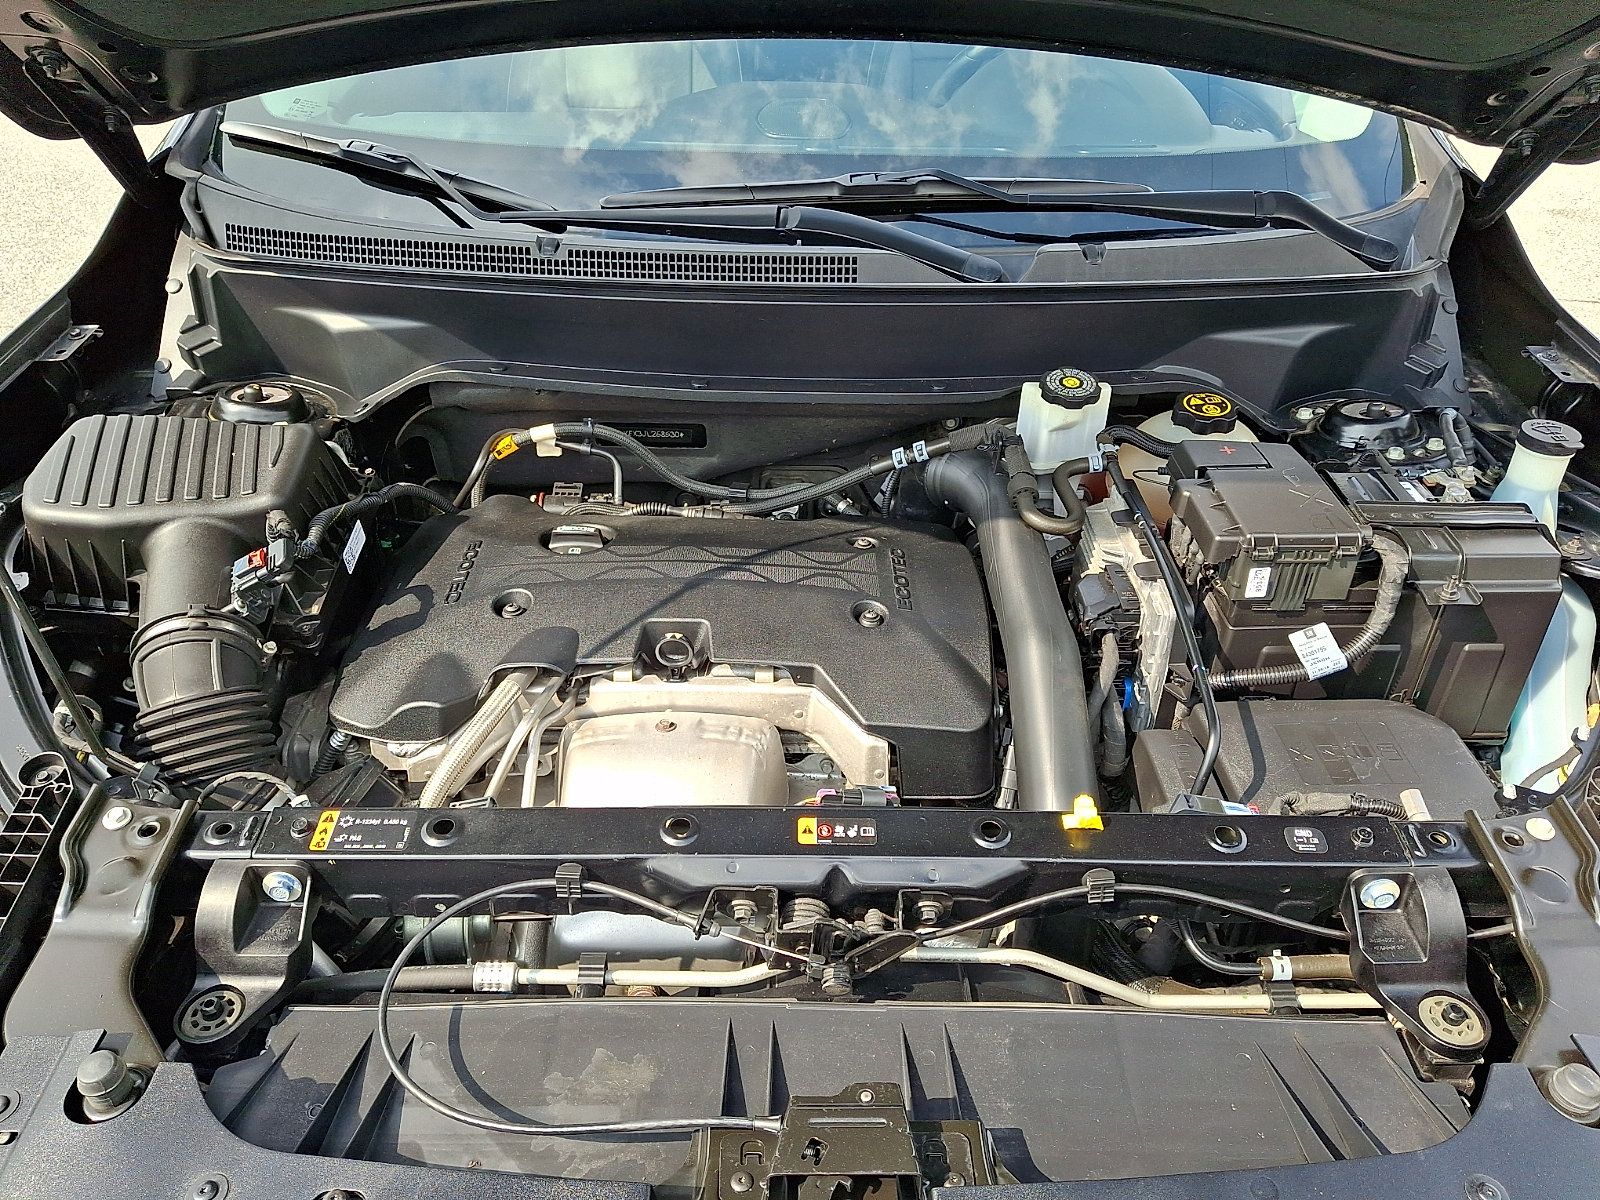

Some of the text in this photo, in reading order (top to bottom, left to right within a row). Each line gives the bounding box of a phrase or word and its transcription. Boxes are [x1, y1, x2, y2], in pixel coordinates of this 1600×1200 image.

[443, 540, 483, 605] ECOTEC
[888, 548, 913, 611] ECOTEC
[1295, 829, 1313, 837] GND
